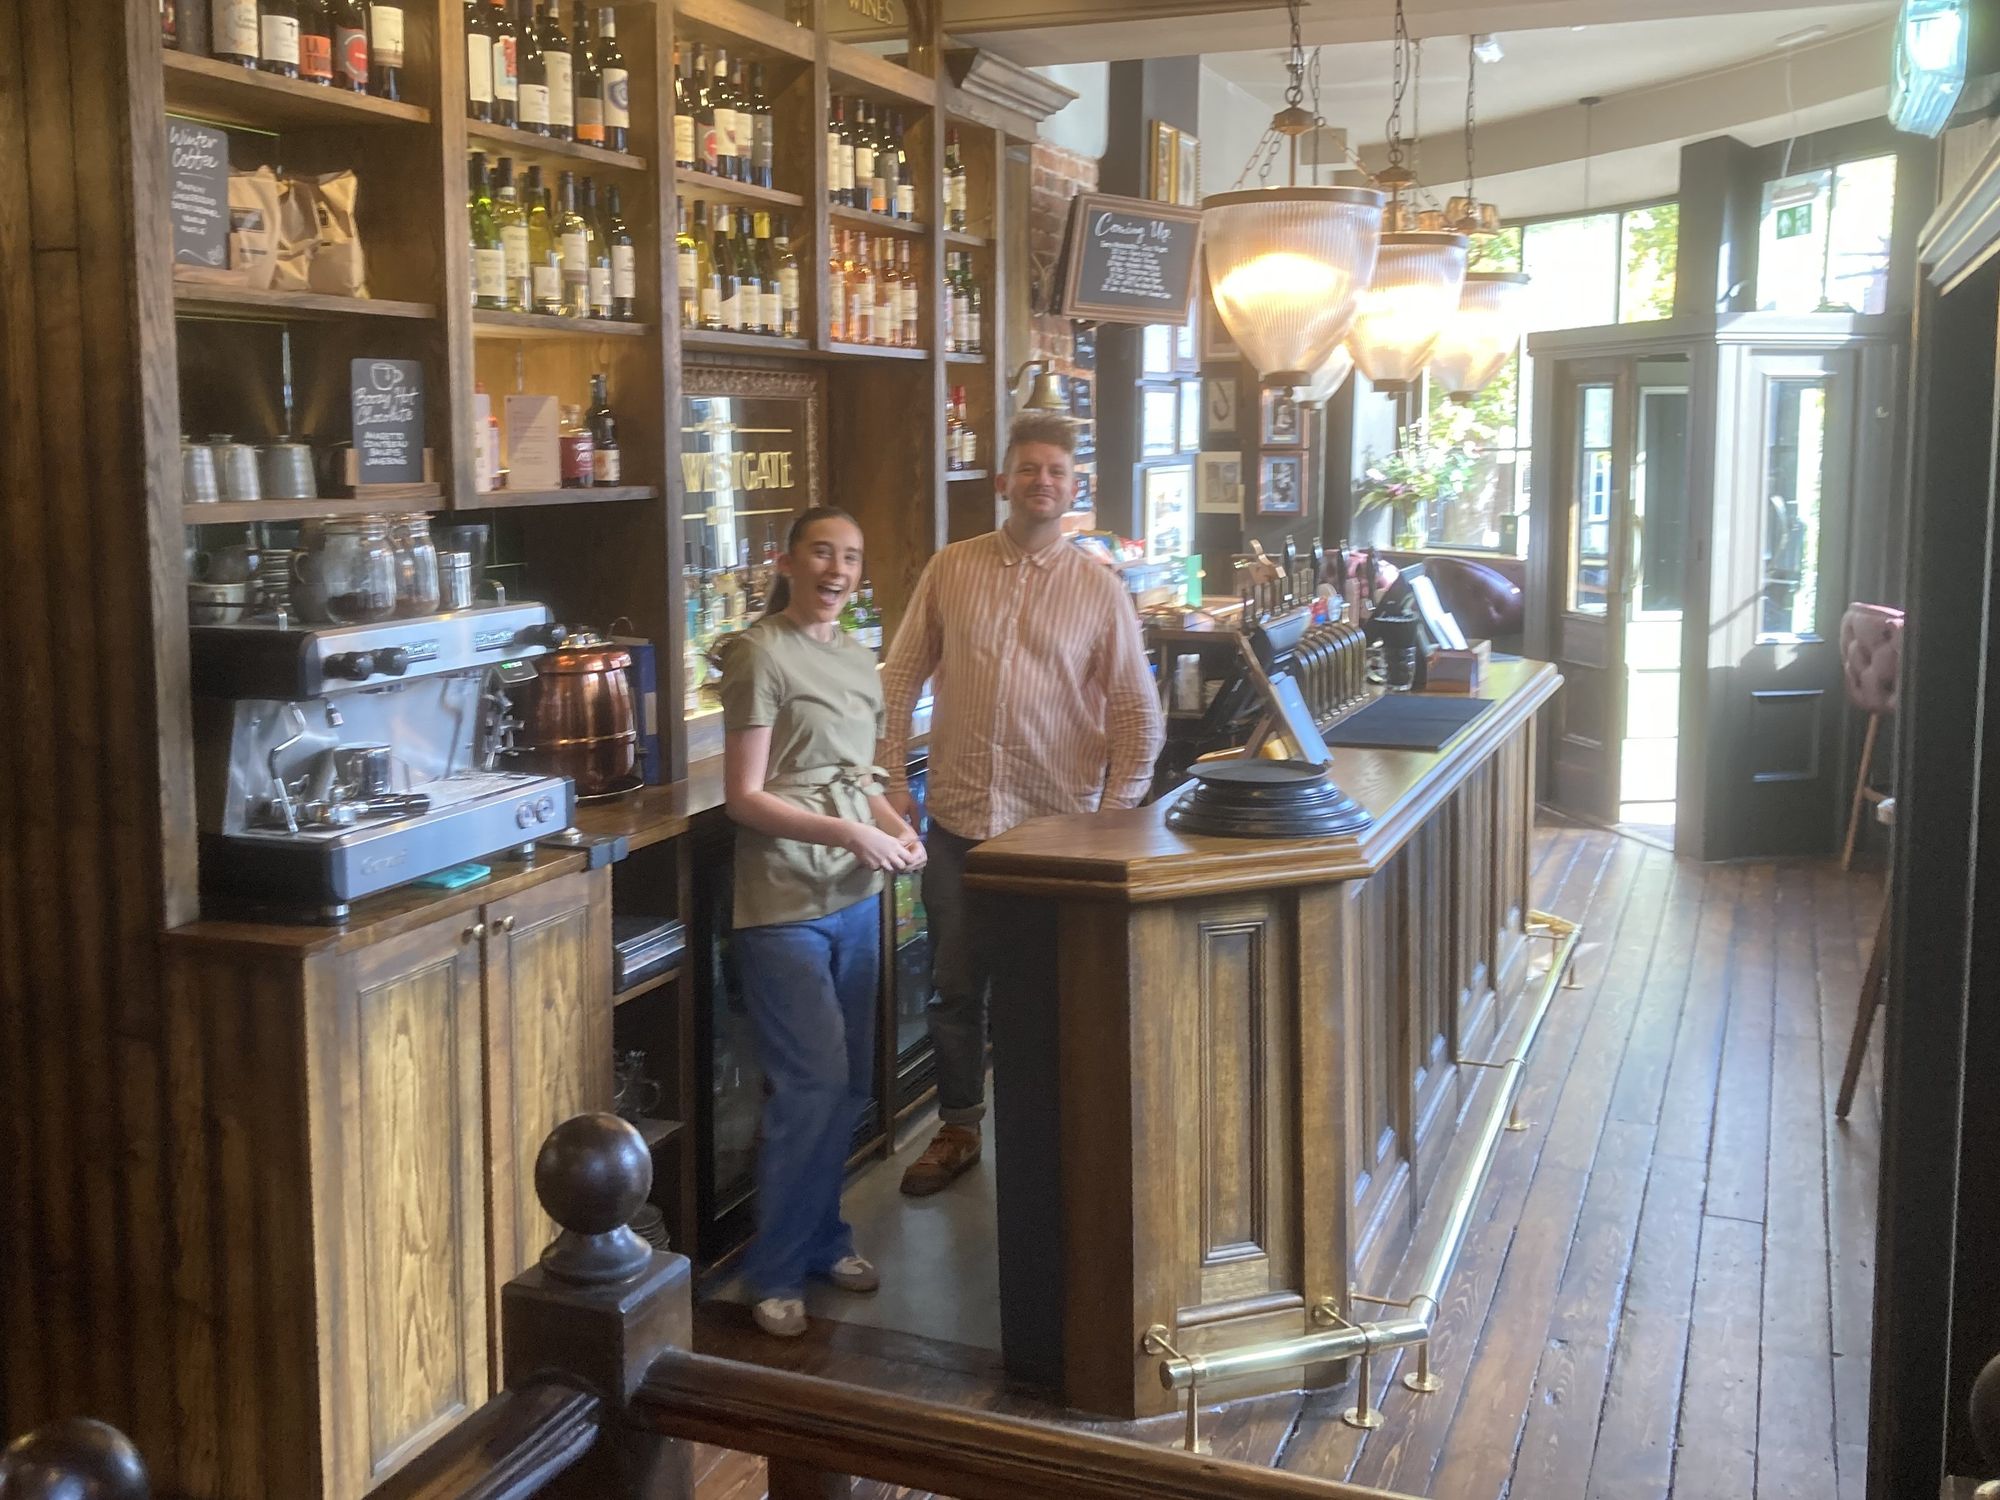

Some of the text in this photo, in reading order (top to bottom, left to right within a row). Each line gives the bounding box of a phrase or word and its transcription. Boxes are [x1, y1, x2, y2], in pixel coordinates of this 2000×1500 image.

[169, 125, 219, 149] Winter
[171, 147, 219, 170] Coffee
[1095, 212, 1146, 245] Coming
[353, 387, 392, 409] Boozy
[355, 405, 414, 426] Chocolate
[680, 451, 795, 493] WESTGATE
